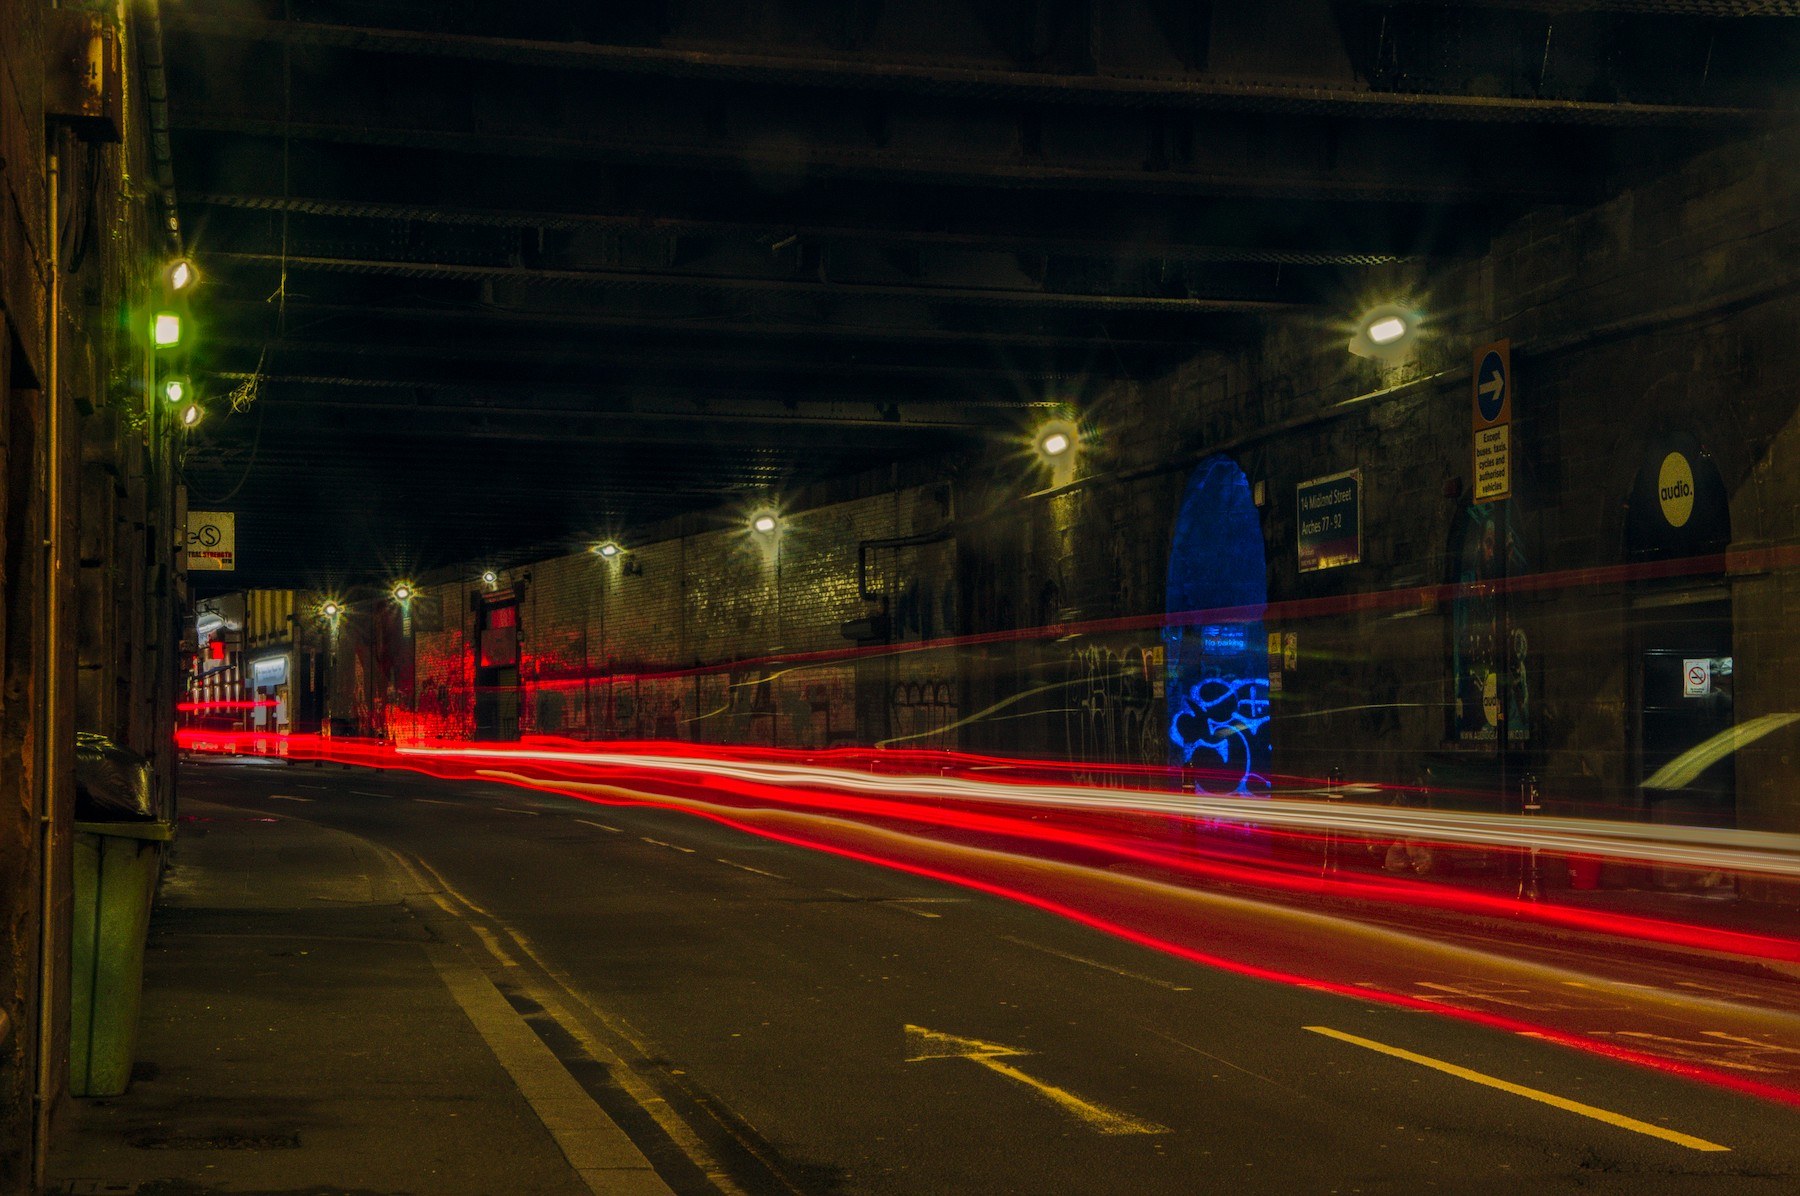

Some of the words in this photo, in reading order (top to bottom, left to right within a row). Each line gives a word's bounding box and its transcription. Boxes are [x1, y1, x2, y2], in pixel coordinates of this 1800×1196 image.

[1483, 431, 1501, 442] Except
[1479, 458, 1494, 470] cycles
[1496, 455, 1505, 466] and
[1479, 468, 1505, 482] authorised
[1482, 482, 1502, 493] vehicles
[1661, 480, 1692, 501] audio.
[1309, 491, 1333, 509] Midland
[1334, 488, 1352, 502] Street
[1301, 520, 1321, 536] Arches
[1321, 516, 1330, 531] 77
[1333, 513, 1342, 529] 92
